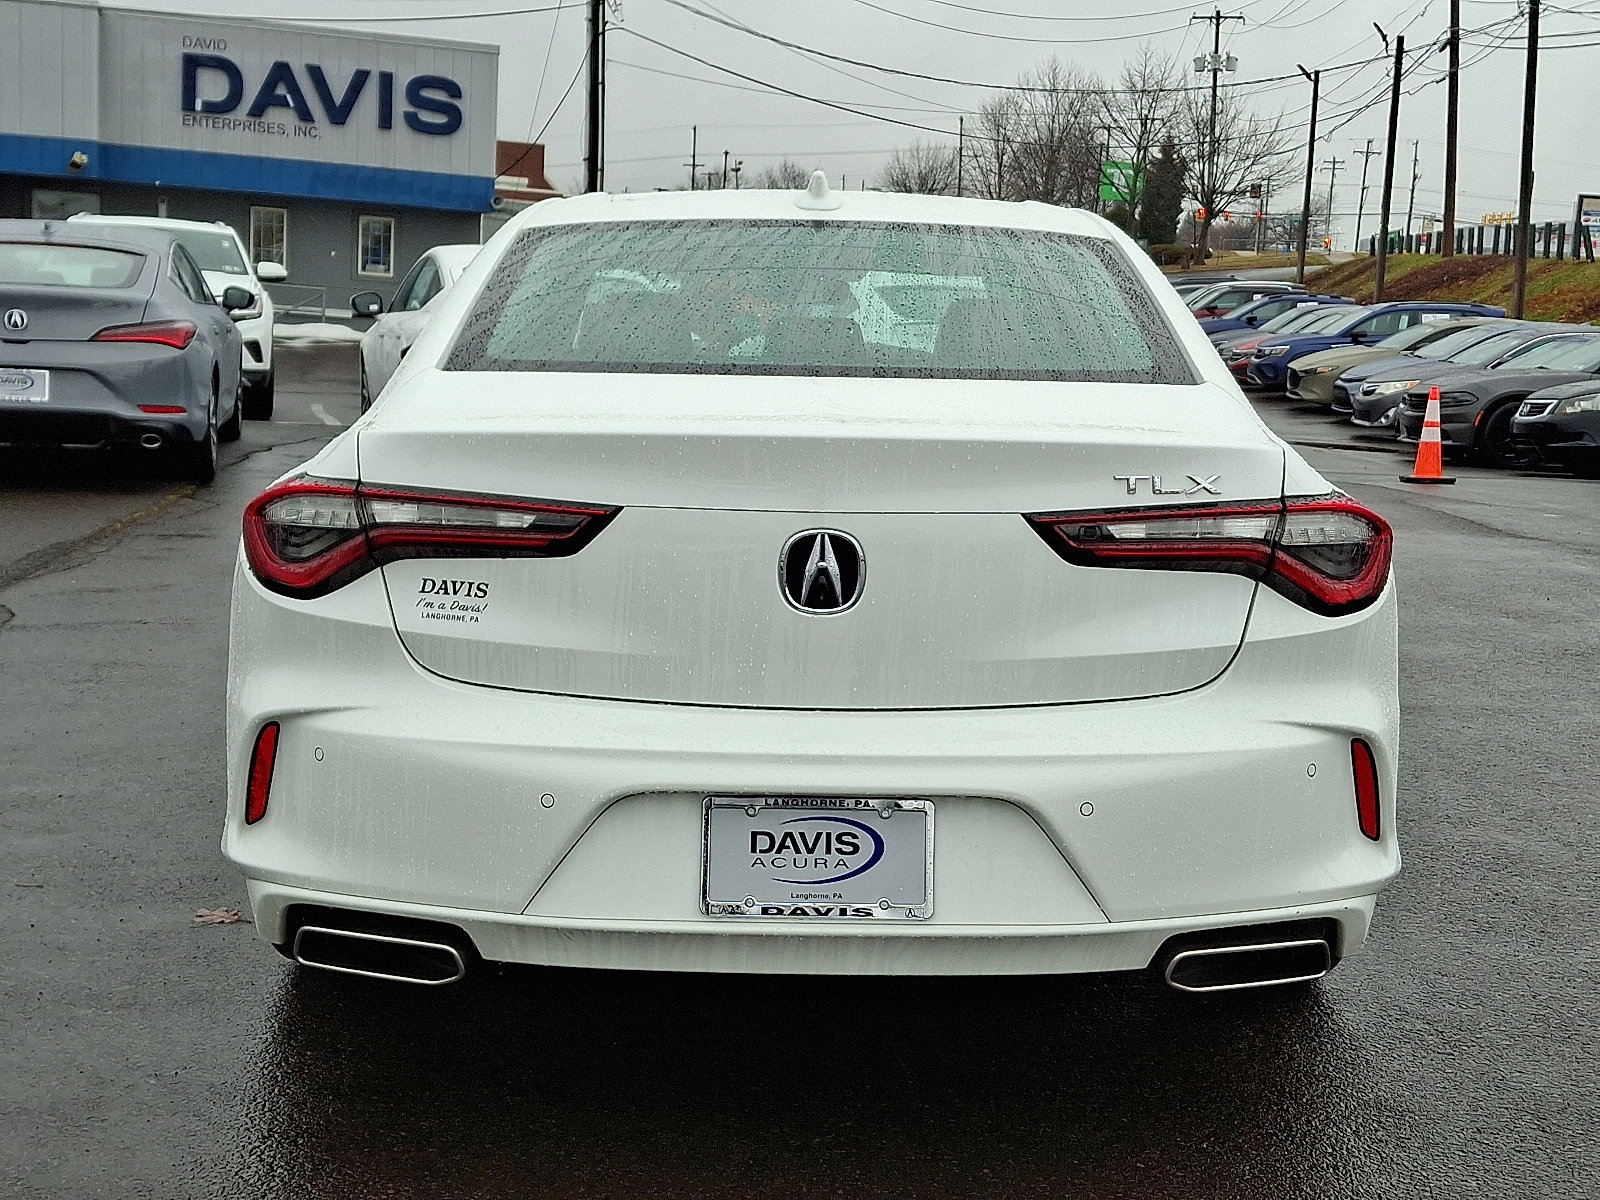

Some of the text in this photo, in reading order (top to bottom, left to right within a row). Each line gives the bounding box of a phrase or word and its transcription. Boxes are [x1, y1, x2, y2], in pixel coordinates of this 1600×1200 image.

[182, 35, 228, 51] DAVID
[181, 52, 463, 136] DAVIS
[182, 113, 323, 139] ENTERPRISES, INC.
[1113, 474, 1223, 497] TLX
[418, 577, 490, 599] DAVIS
[415, 597, 489, 614] I'm a Davis!
[421, 611, 480, 623] LANGHORNE, PA
[764, 798, 850, 808] LANGHORNE,
[750, 830, 861, 856] DAVIS
[750, 856, 850, 870] ACURA
[790, 892, 831, 900] Langhorne,
[760, 906, 875, 918] DAVIS
